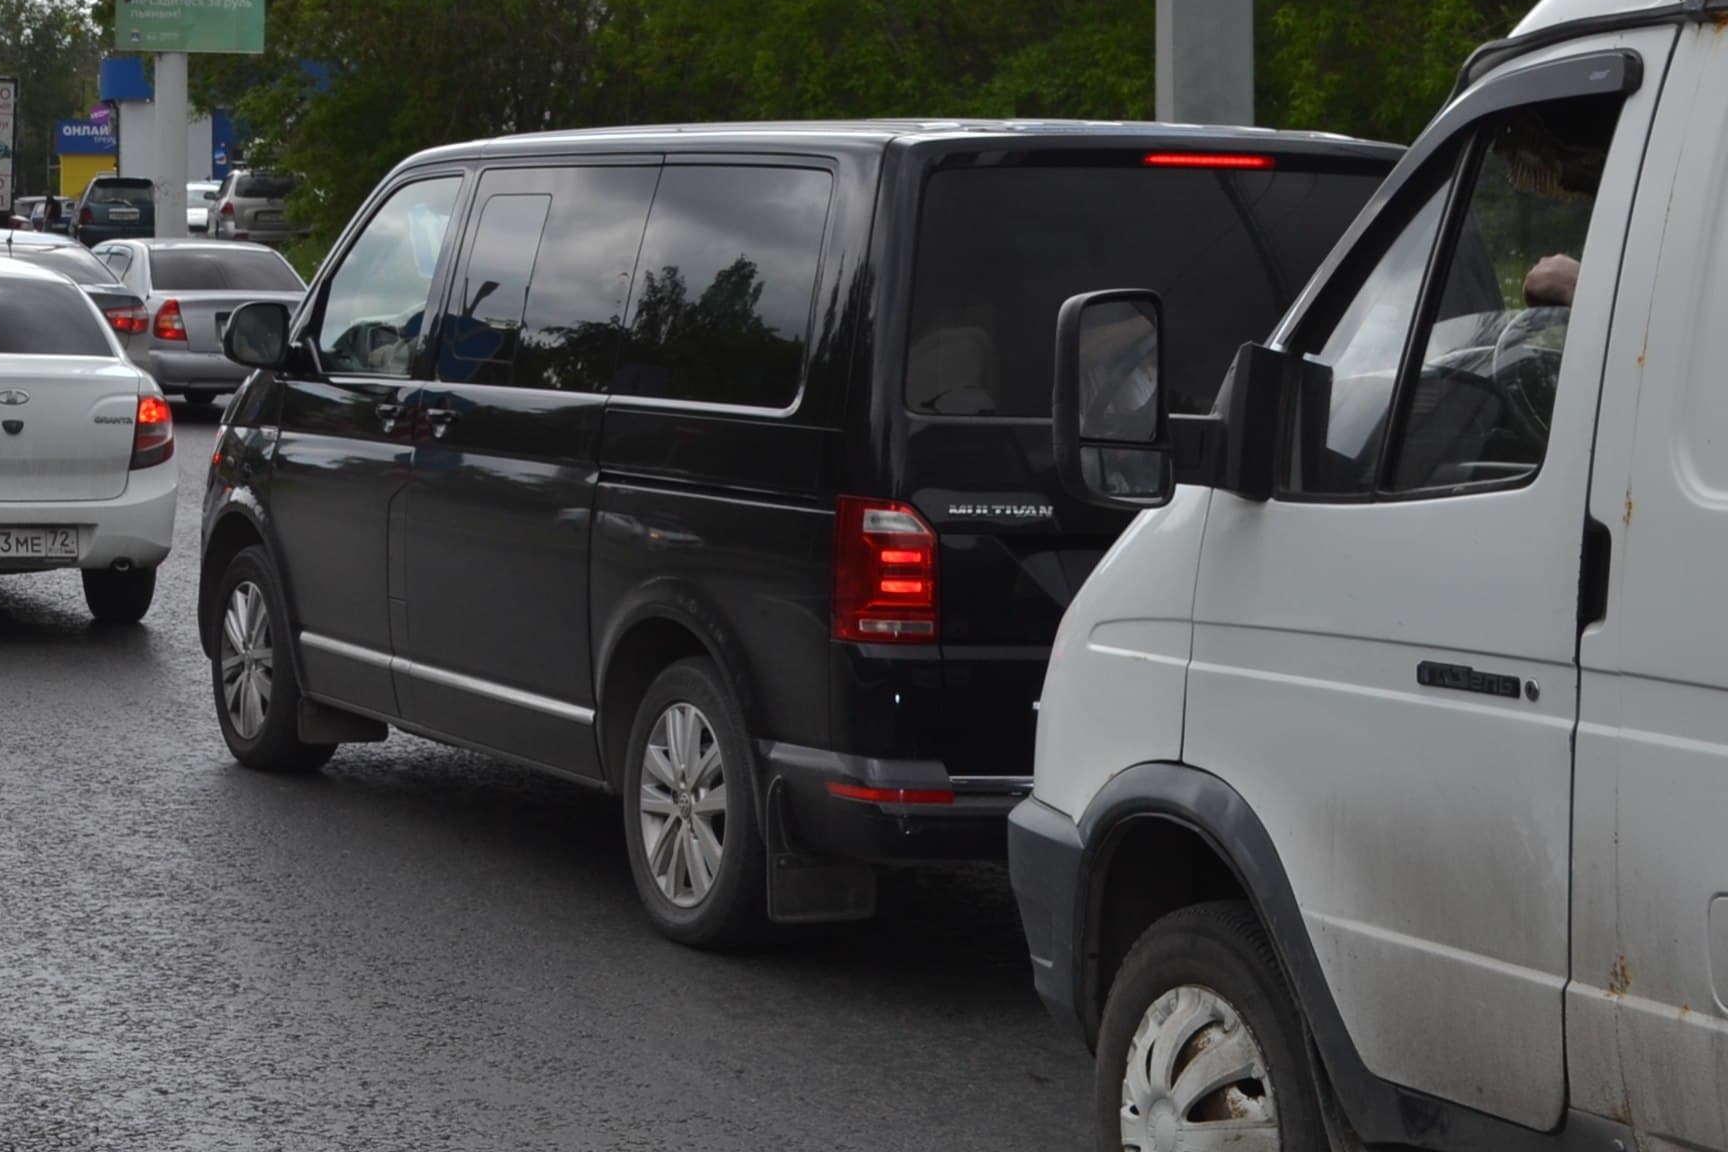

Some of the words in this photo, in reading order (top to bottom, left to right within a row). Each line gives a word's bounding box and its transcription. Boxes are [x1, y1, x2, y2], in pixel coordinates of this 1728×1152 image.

[63, 124, 110, 136] ОНЛАЙ
[94, 416, 133, 424] GRANTA
[949, 504, 1053, 518] MULTIVAN
[49, 530, 70, 547] 72
